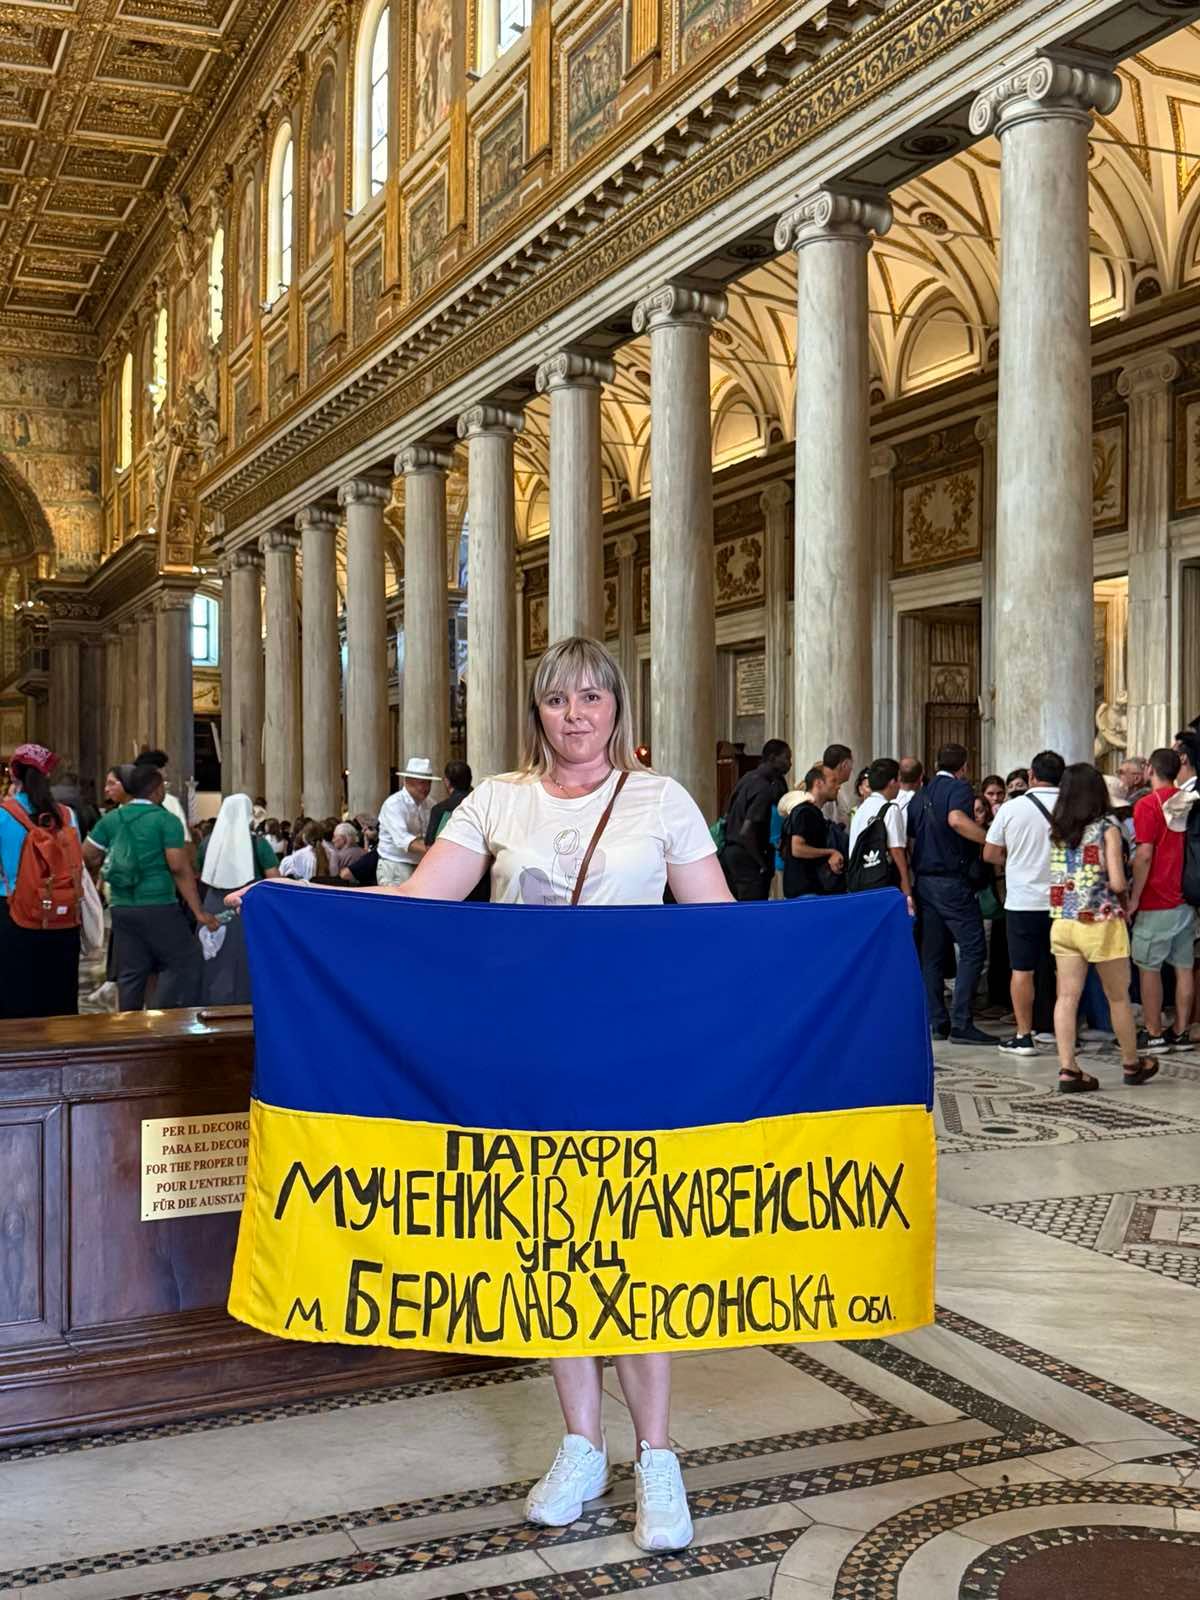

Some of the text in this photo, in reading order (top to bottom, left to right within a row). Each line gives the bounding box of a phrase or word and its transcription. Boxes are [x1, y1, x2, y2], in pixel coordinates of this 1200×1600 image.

[162, 1120, 250, 1137] PER IL DECORO
[162, 1143, 192, 1155] PARA
[195, 1142, 209, 1152] EL
[446, 1130, 658, 1178] ПАРАФІЯ
[146, 1164, 168, 1175] FOR
[169, 1161, 192, 1173] THE
[194, 1157, 234, 1171] PROPER
[156, 1181, 187, 1193] POUR
[153, 1198, 175, 1212] FÜR
[178, 1197, 197, 1209] DIE
[274, 1156, 910, 1243] МУЧЕНИКІВ МАКАВЕЙСЬКИХ
[516, 1239, 627, 1274] УГКЦ
[344, 1259, 578, 1345] БЕРИСЛАВ
[588, 1272, 839, 1341] ХЕРСОНСЬКА
